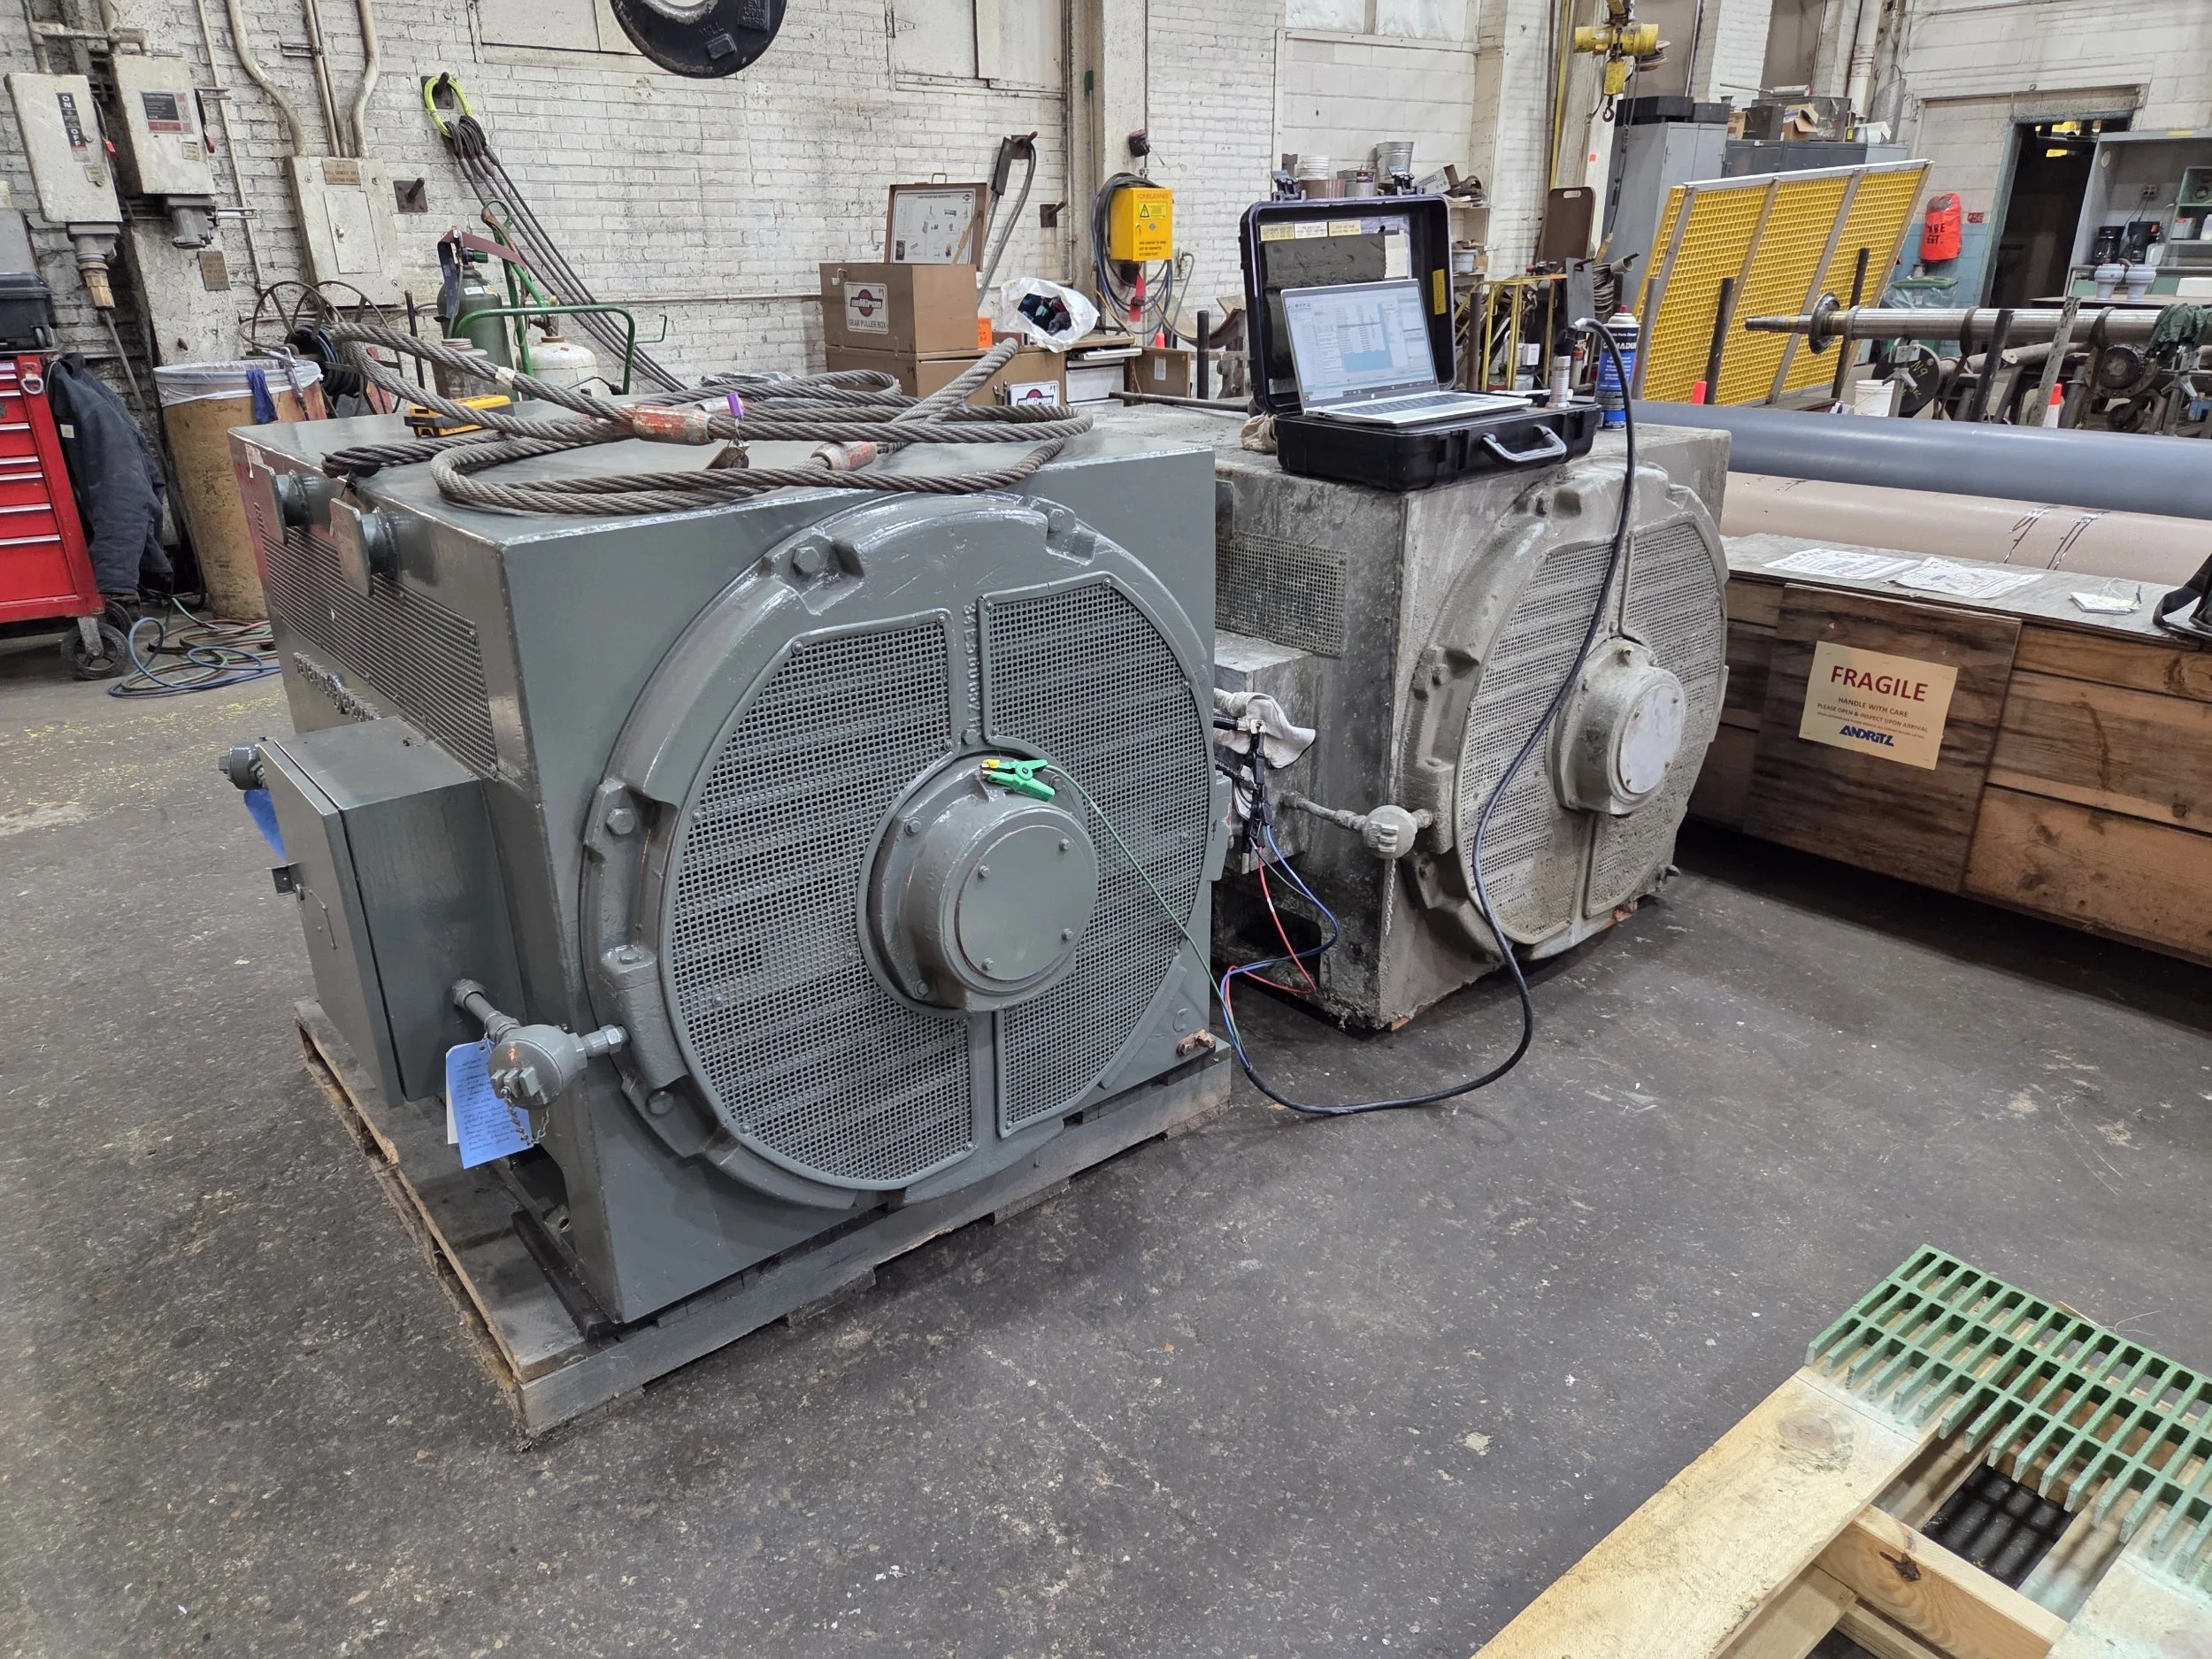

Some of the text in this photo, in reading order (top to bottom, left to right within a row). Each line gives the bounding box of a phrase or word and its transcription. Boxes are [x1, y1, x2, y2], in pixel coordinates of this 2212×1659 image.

[62, 96, 72, 108] ON
[71, 128, 81, 147] OFF
[849, 319, 887, 329] GEAR PULLER BOX
[1830, 664, 1929, 703] FRAGILE
[1838, 696, 1909, 718] HANDLE WITH CARE
[1816, 703, 1838, 713] PLEASE
[1837, 707, 1853, 717] OPEN
[1860, 712, 1884, 723] INSPECT
[1884, 718, 1901, 727] UPON
[1902, 721, 1929, 733] ARRIVAL
